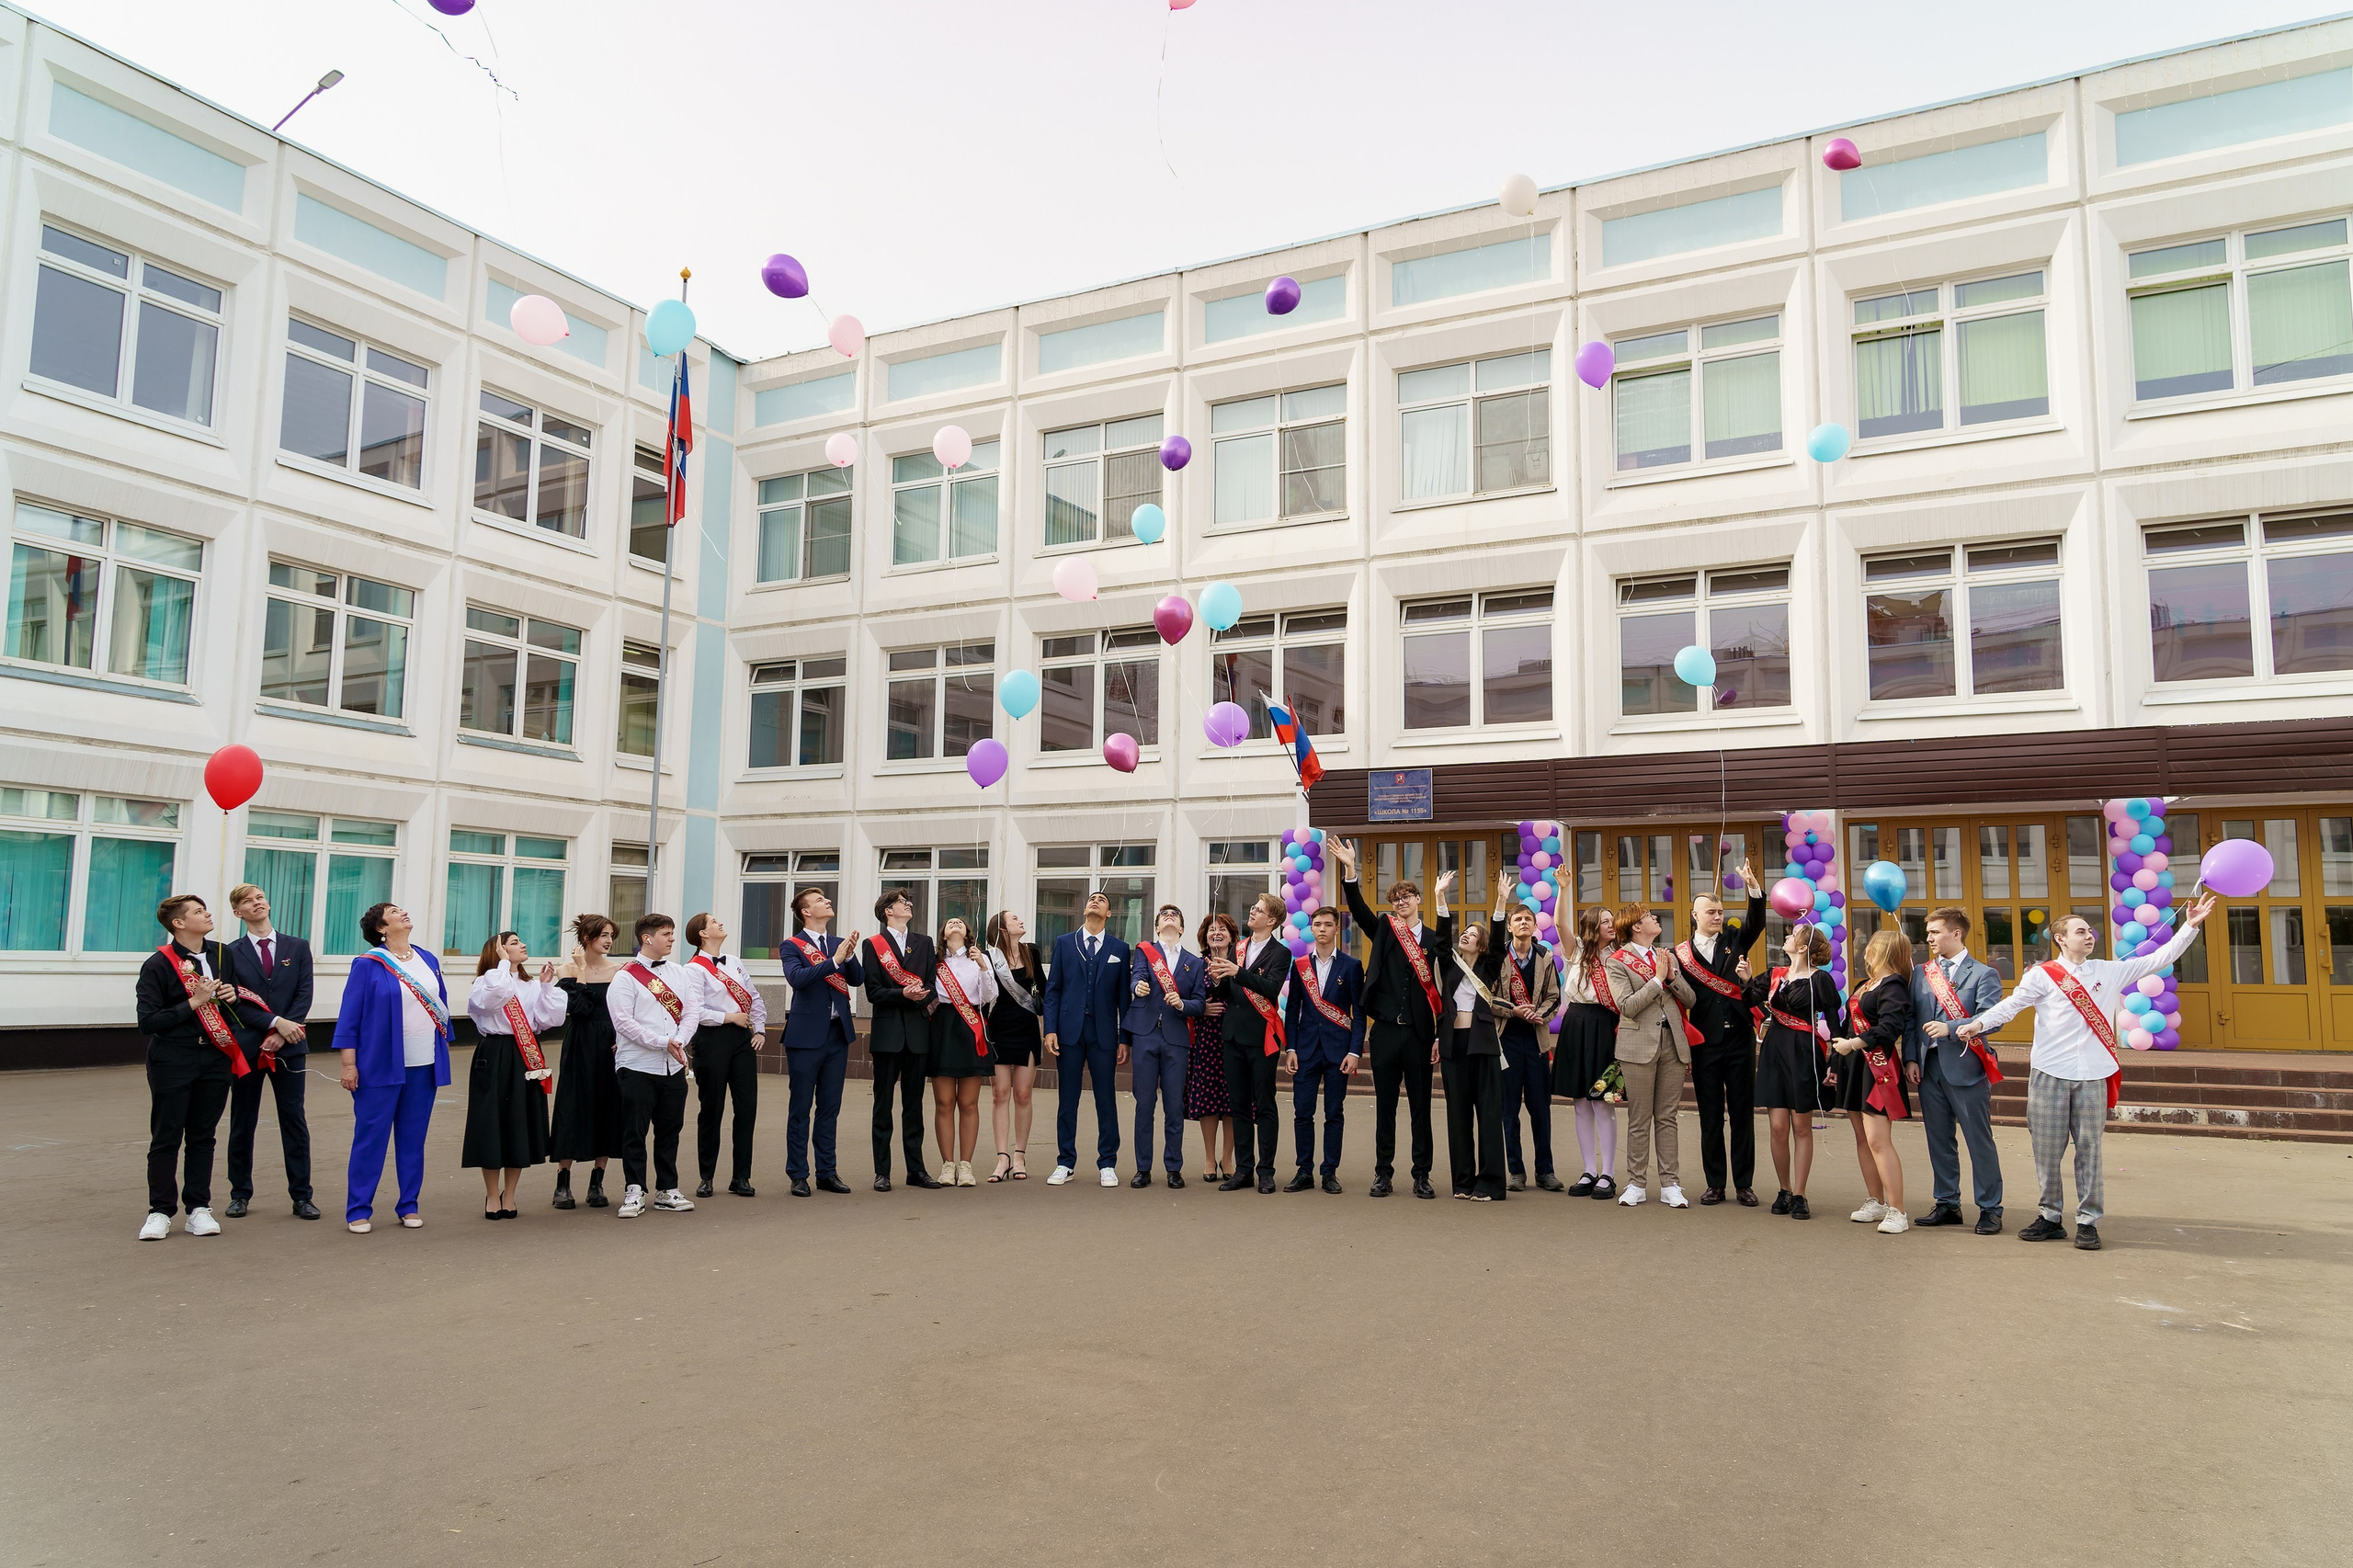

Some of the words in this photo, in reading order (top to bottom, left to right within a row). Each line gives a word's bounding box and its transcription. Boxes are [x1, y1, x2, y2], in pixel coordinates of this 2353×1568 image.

[1414, 959, 1431, 982] 2023
[1707, 977, 1735, 994] 2023
[959, 1003, 980, 1025] 2023
[2069, 988, 2115, 1046] Выпускник
[522, 1044, 543, 1070] 2023
